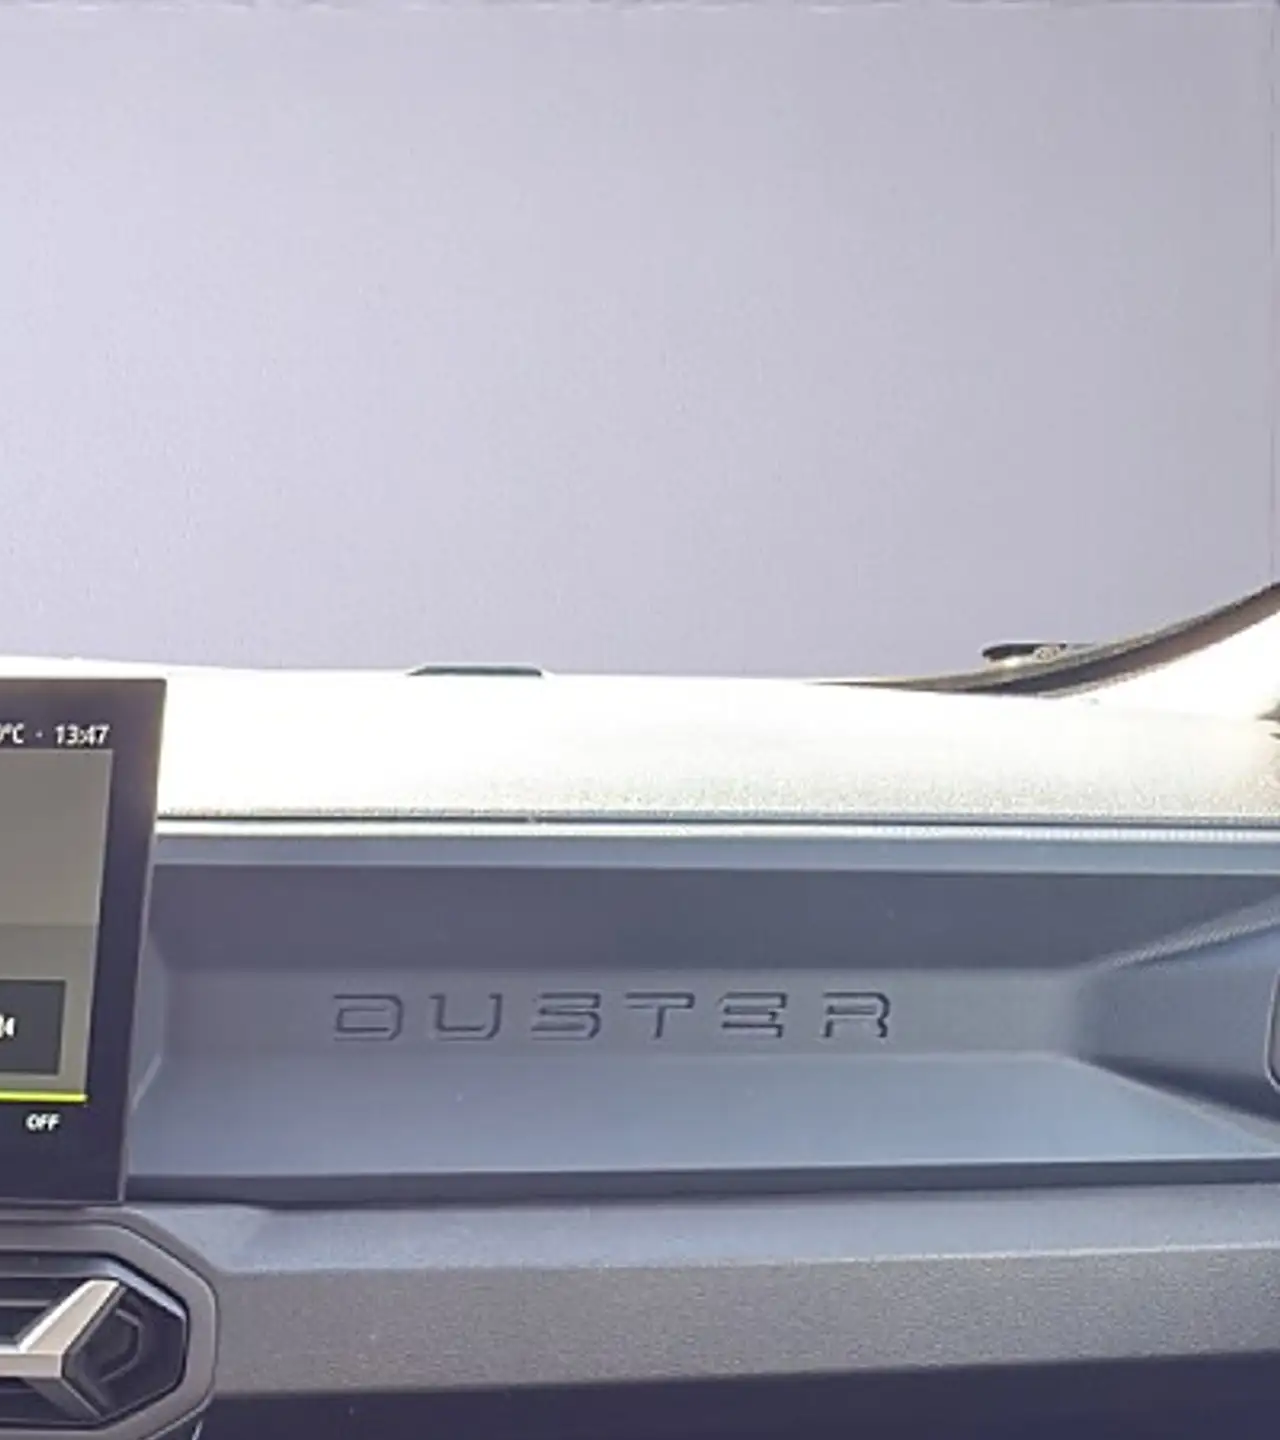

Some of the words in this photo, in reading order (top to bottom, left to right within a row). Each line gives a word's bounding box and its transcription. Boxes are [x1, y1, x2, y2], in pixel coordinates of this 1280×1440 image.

[55, 724, 110, 746] 13:47
[333, 991, 892, 1042] DUSTER
[26, 1112, 61, 1132] OFF
